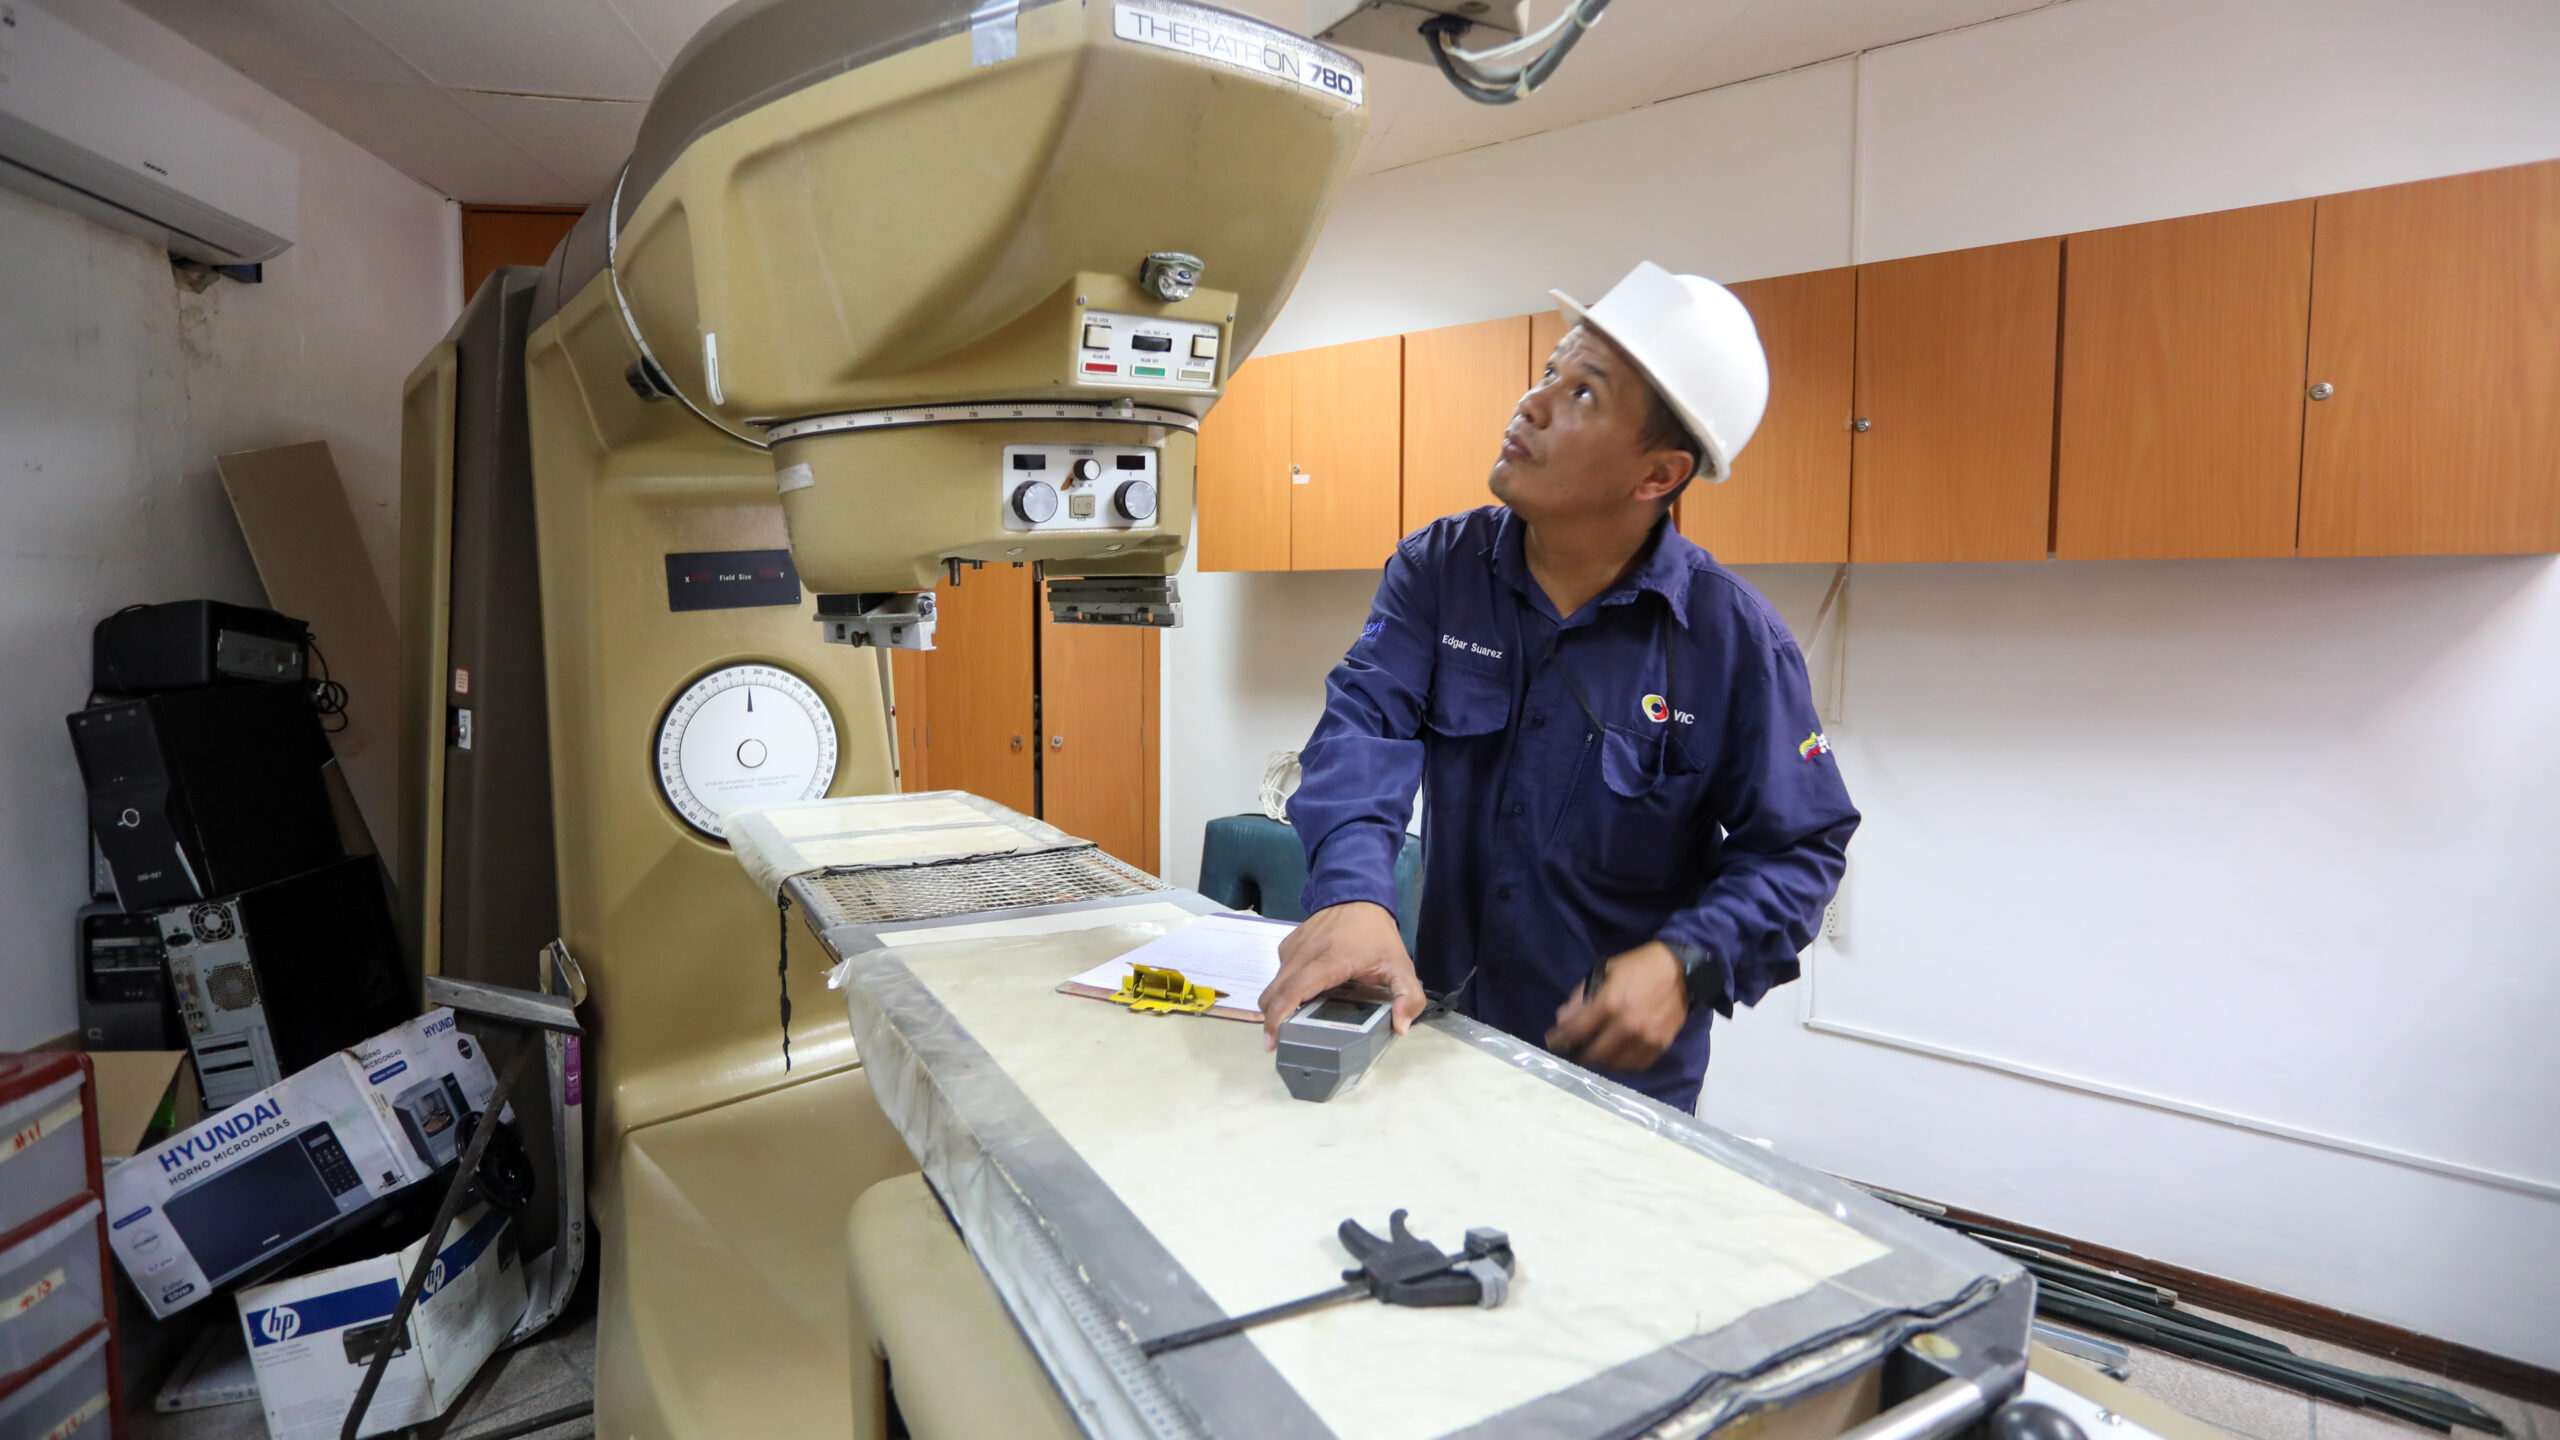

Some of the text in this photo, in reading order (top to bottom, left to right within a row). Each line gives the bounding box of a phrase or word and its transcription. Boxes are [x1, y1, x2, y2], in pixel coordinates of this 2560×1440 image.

[1130, 12, 1352, 95] THERATRON 780
[1442, 634, 1503, 659] Edgar Suarez
[677, 705, 685, 713] 50
[670, 718, 677, 727] 60
[678, 801, 687, 810] 120
[688, 811, 697, 821] 130
[158, 1098, 282, 1172] HYUNDAI
[170, 1118, 290, 1186] HORNO MICROONDAS
[269, 1307, 294, 1341] hp
